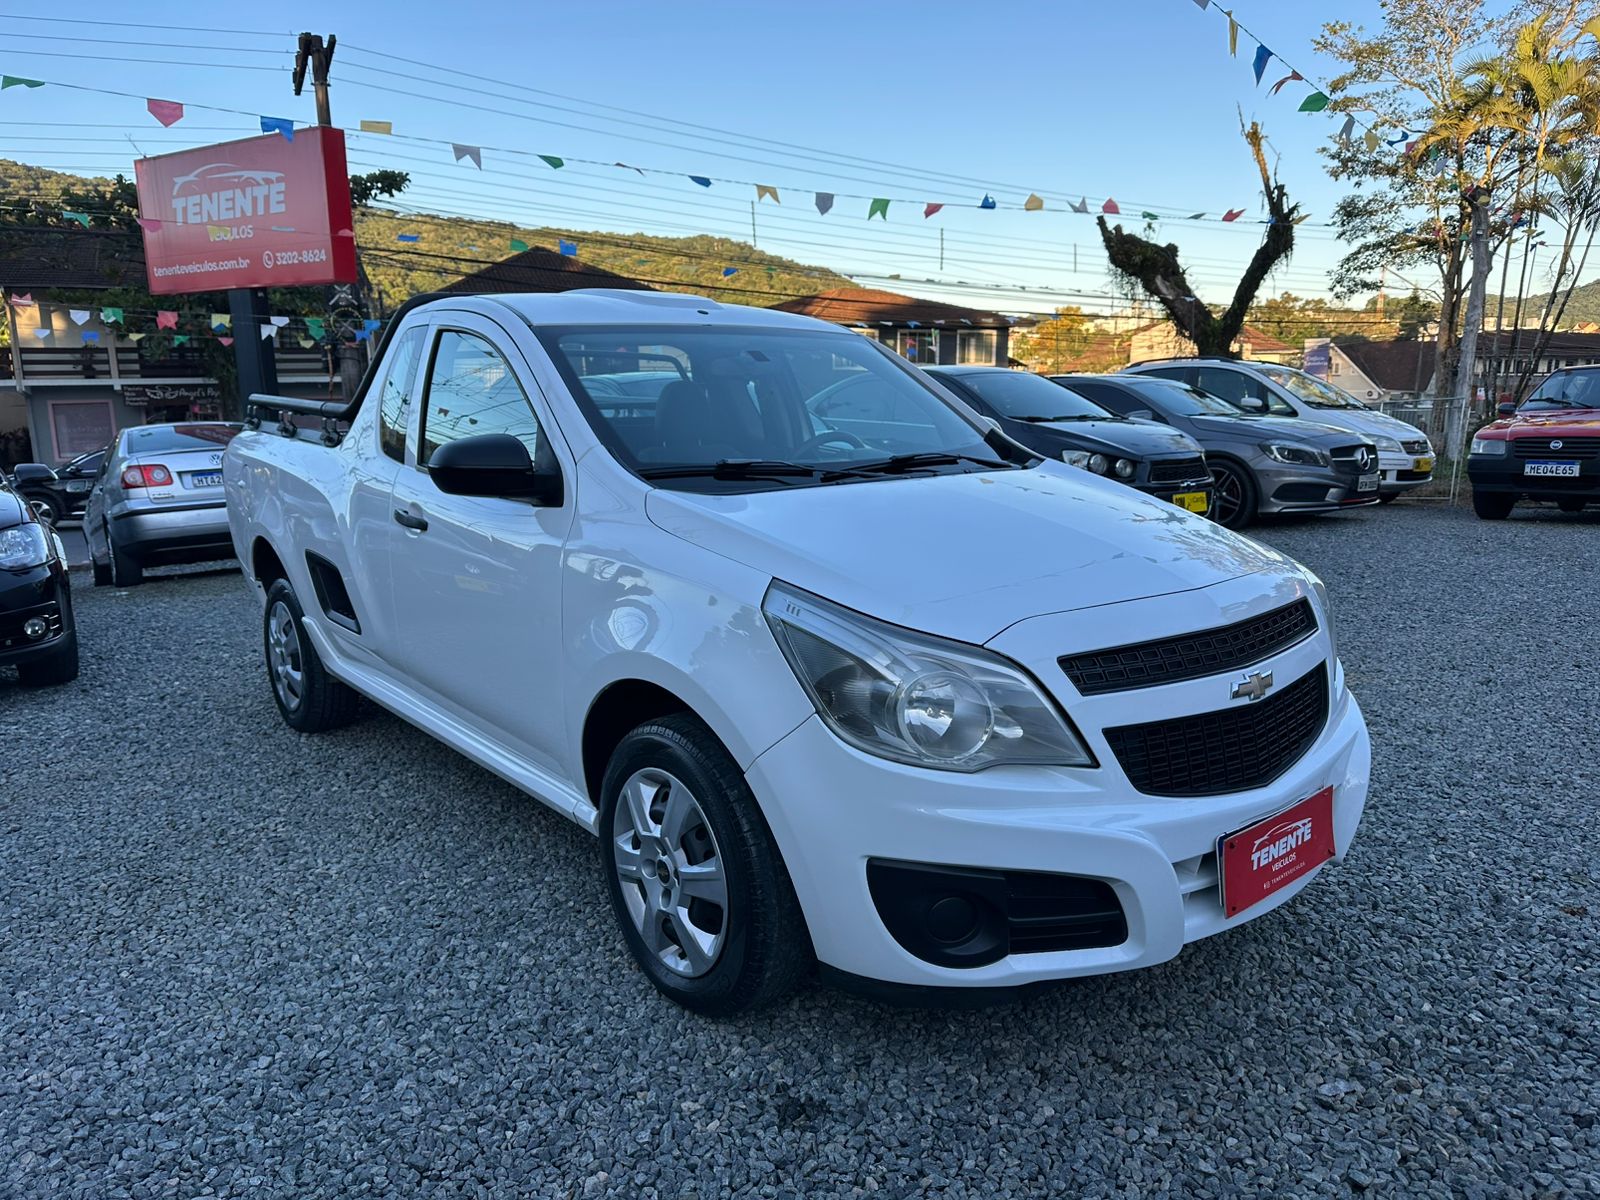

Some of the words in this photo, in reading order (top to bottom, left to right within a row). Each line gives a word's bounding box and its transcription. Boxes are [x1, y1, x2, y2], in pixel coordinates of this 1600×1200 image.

[172, 182, 286, 226] TENENTE
[153, 257, 250, 278] tenenteveiculos.com.br
[275, 249, 327, 266] 3202-8624
[1251, 822, 1312, 871] TENENTE
